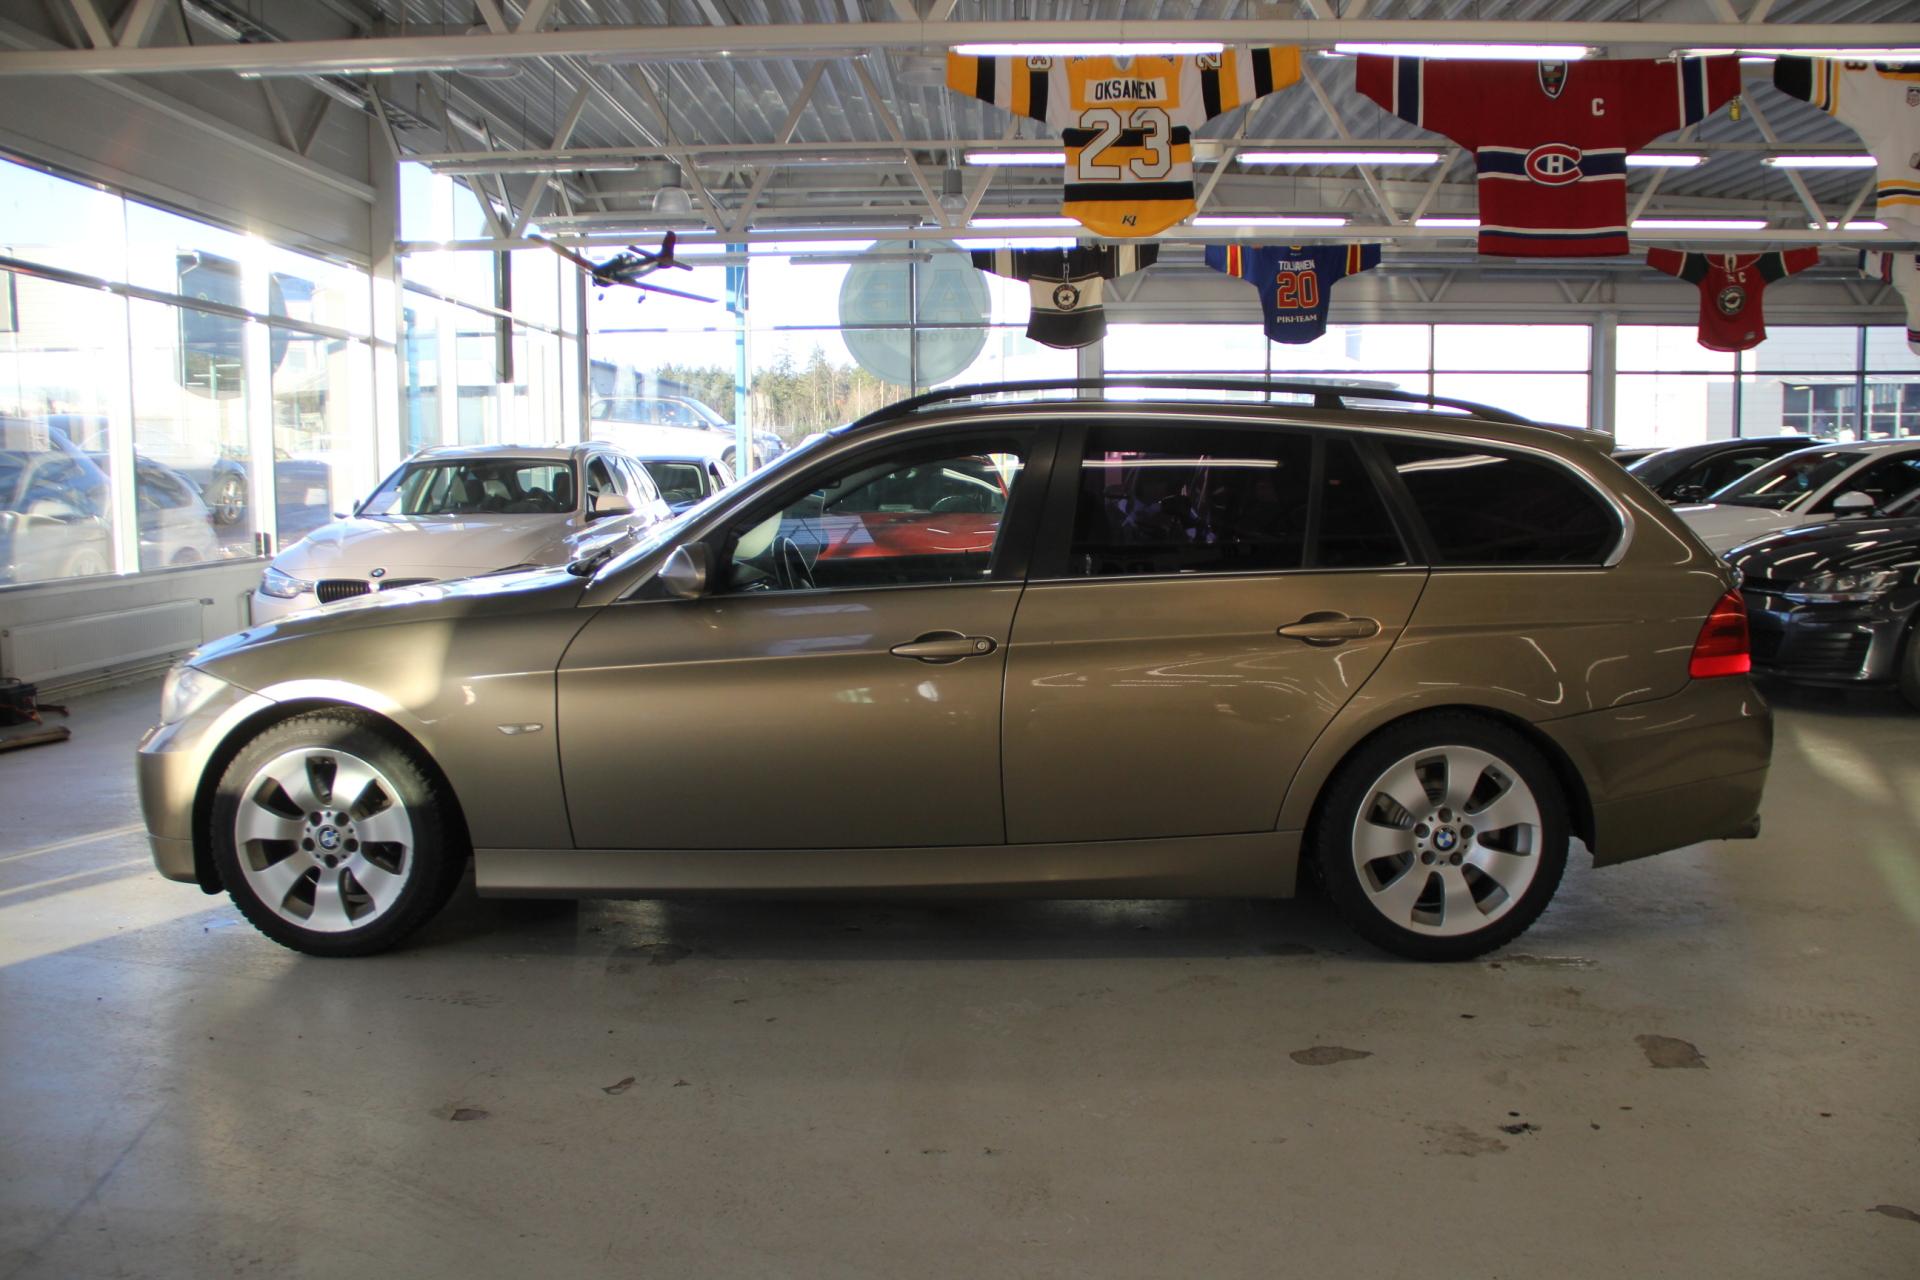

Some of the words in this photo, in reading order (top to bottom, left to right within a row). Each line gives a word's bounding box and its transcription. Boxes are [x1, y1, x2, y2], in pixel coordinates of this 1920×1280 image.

[1095, 80, 1157, 101] OKSANEN
[1591, 97, 1606, 117] C
[1079, 107, 1173, 180] 23
[1276, 270, 1320, 309] 20
